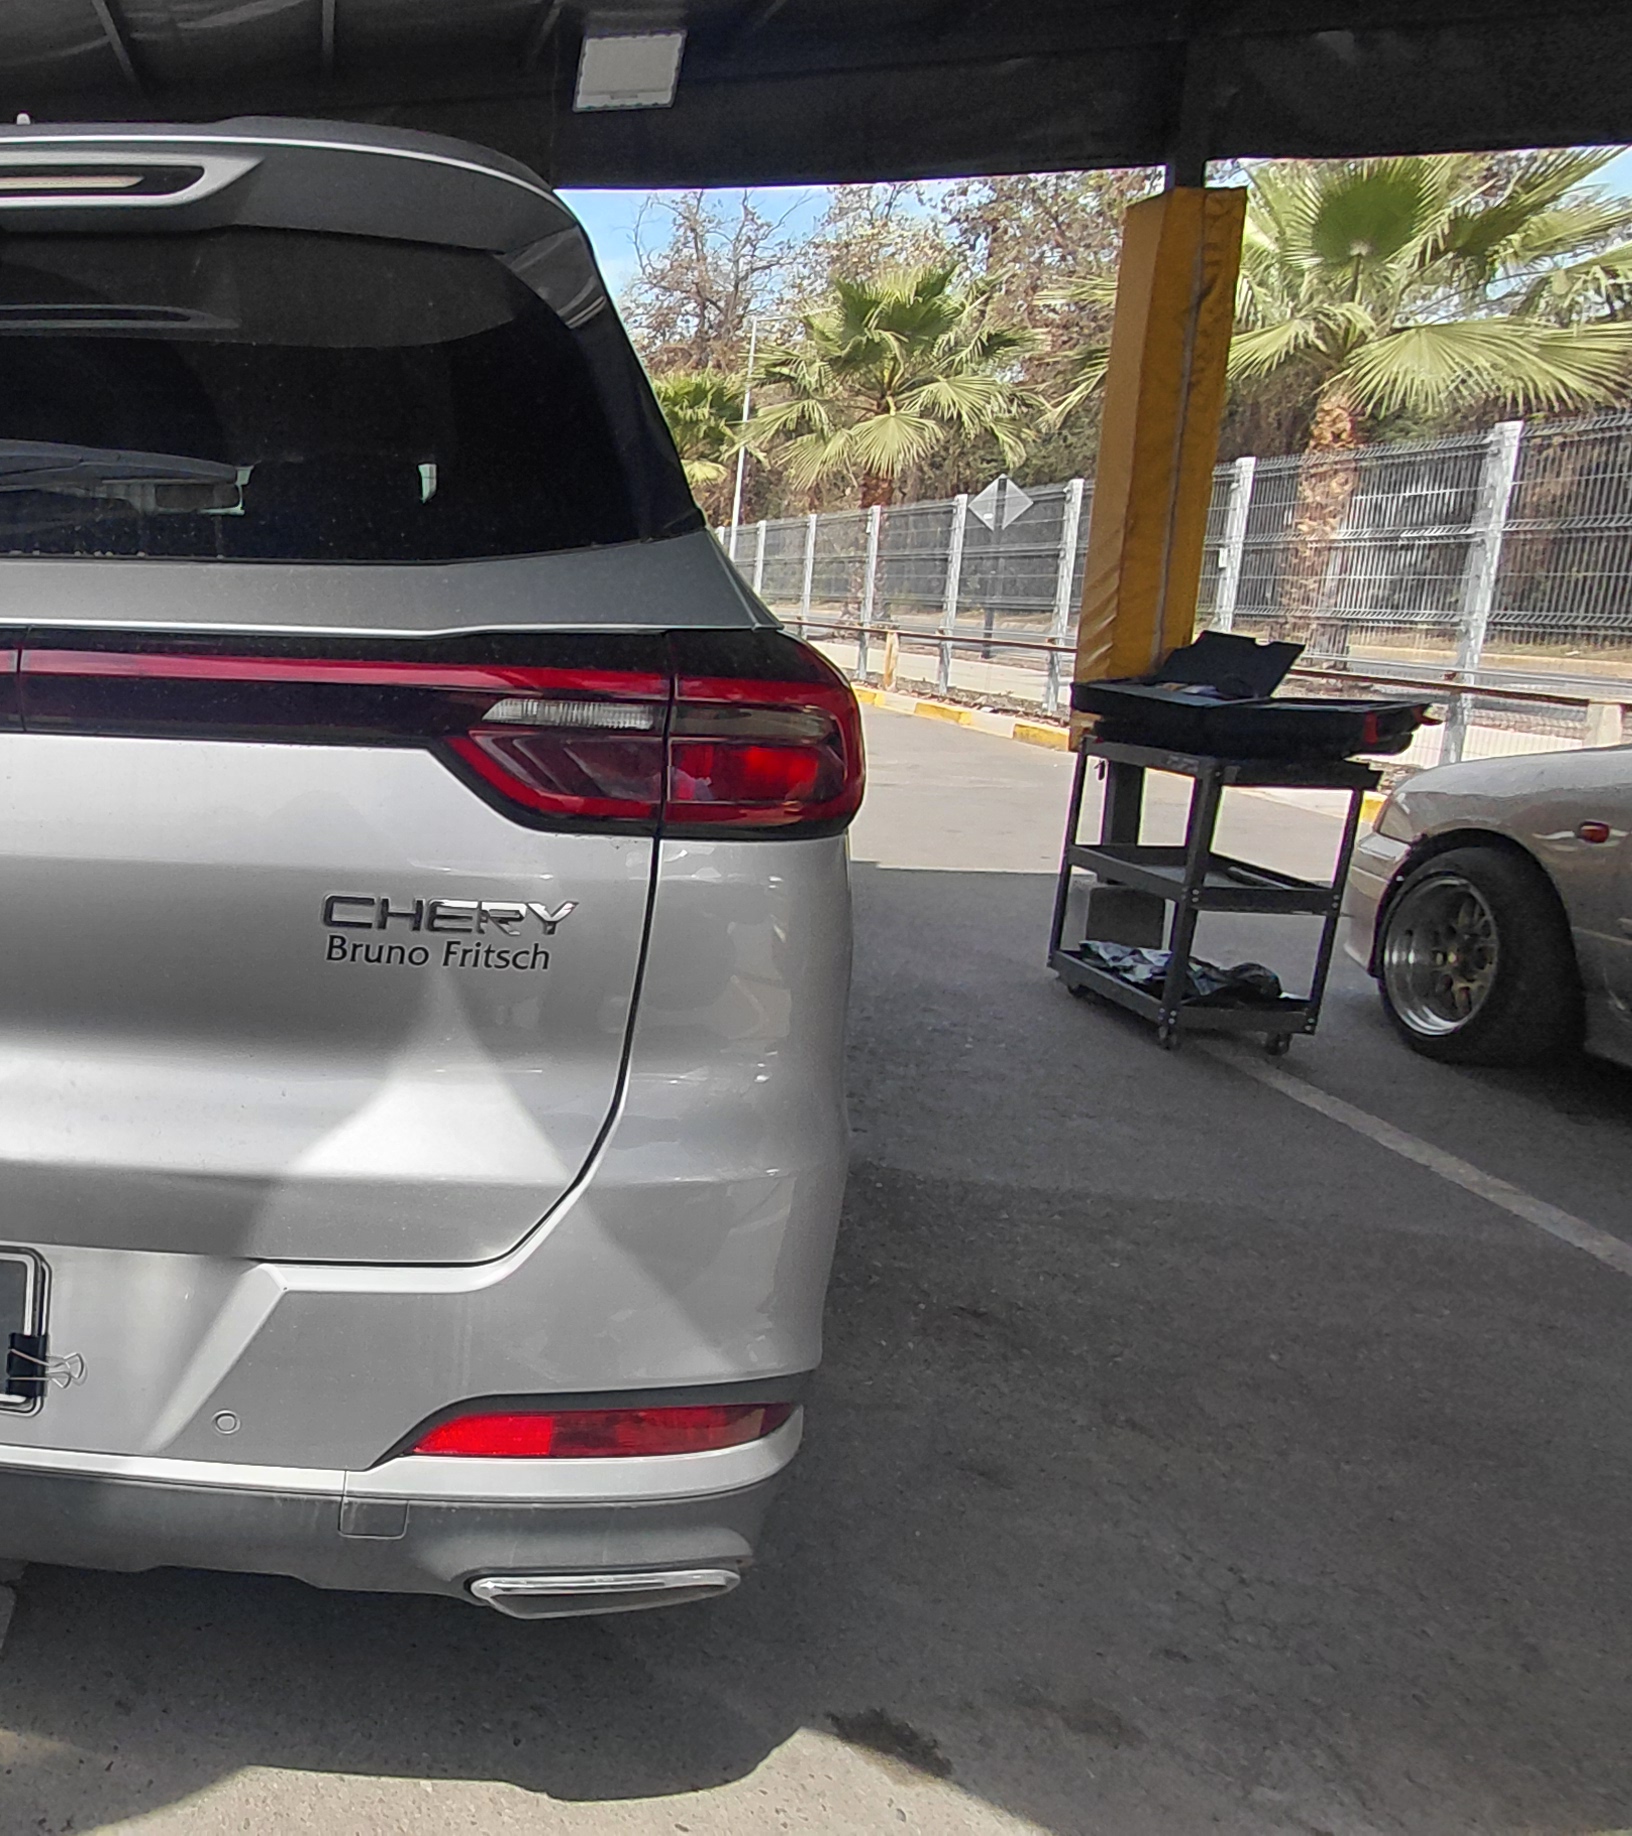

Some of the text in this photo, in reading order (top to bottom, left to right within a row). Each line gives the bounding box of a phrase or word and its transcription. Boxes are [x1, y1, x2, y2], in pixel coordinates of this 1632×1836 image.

[322, 892, 579, 936] CHERY
[325, 934, 550, 971] Bruno Fritsch
